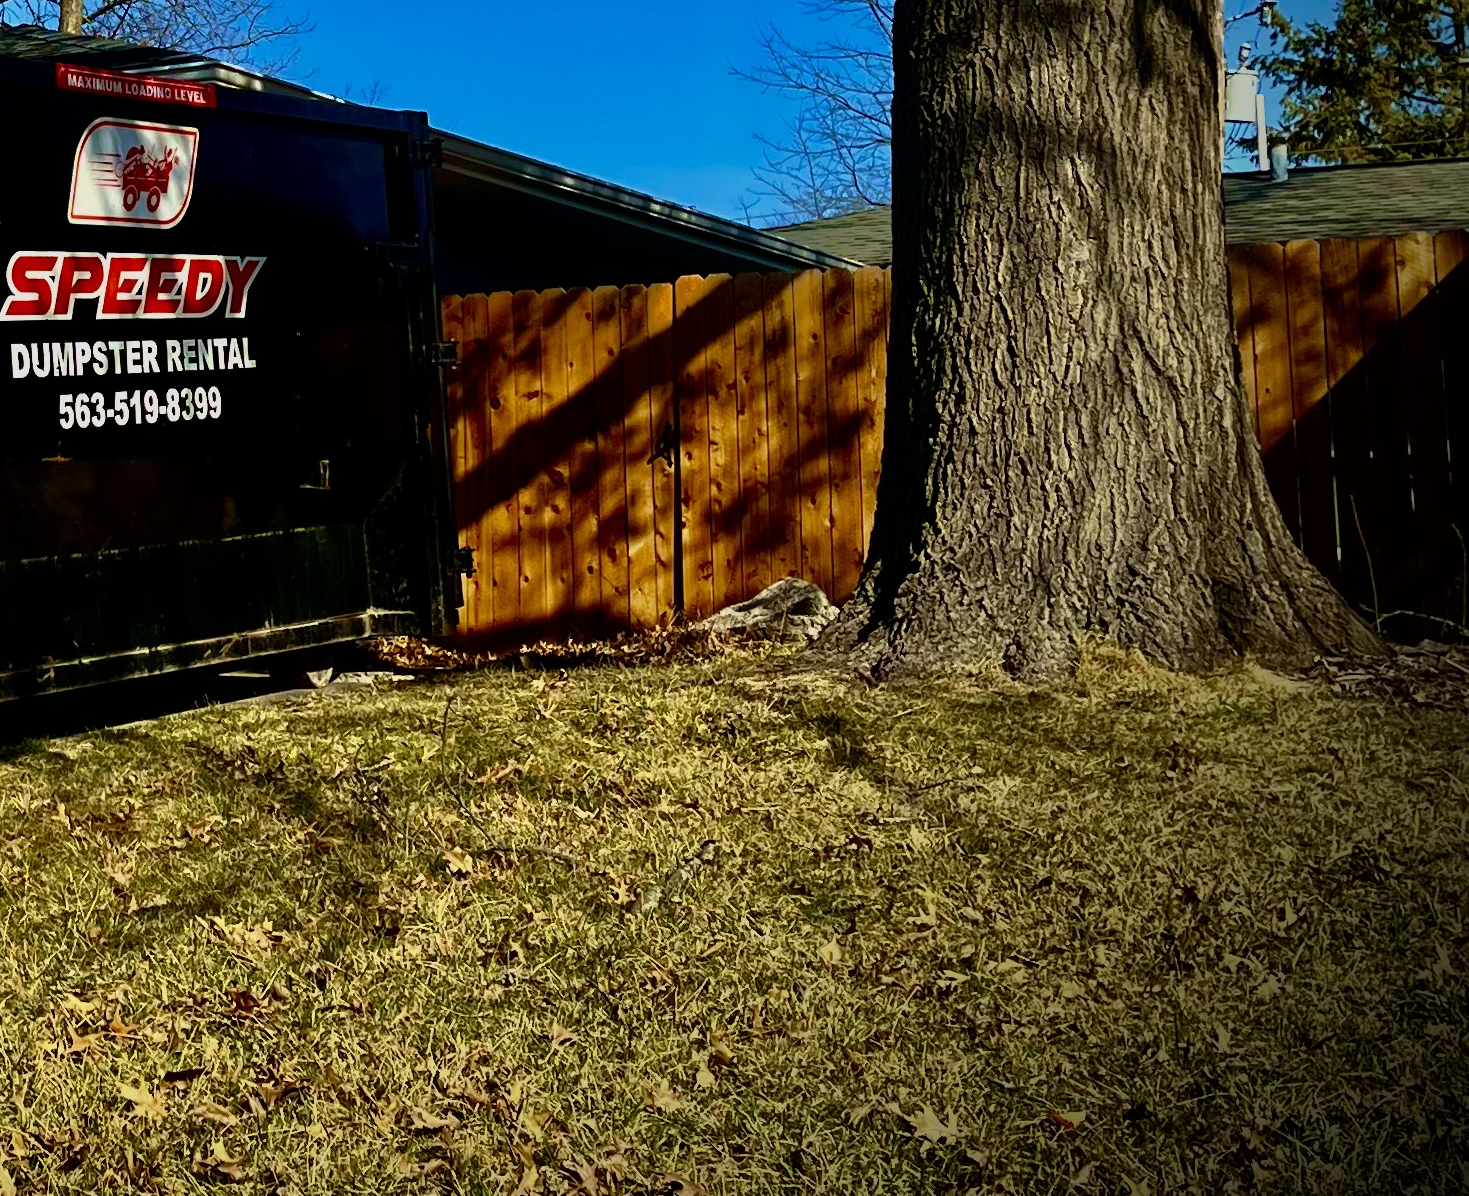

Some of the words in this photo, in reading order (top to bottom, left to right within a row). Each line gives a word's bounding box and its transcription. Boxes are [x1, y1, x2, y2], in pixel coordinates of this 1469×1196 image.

[68, 74, 122, 94] MAXIMUM
[125, 83, 172, 100] LOADING
[174, 88, 206, 104] LEVEL
[10, 340, 161, 378] DUMPSTER
[166, 337, 257, 372] RENTAL
[59, 386, 222, 429] 563-519-8399
